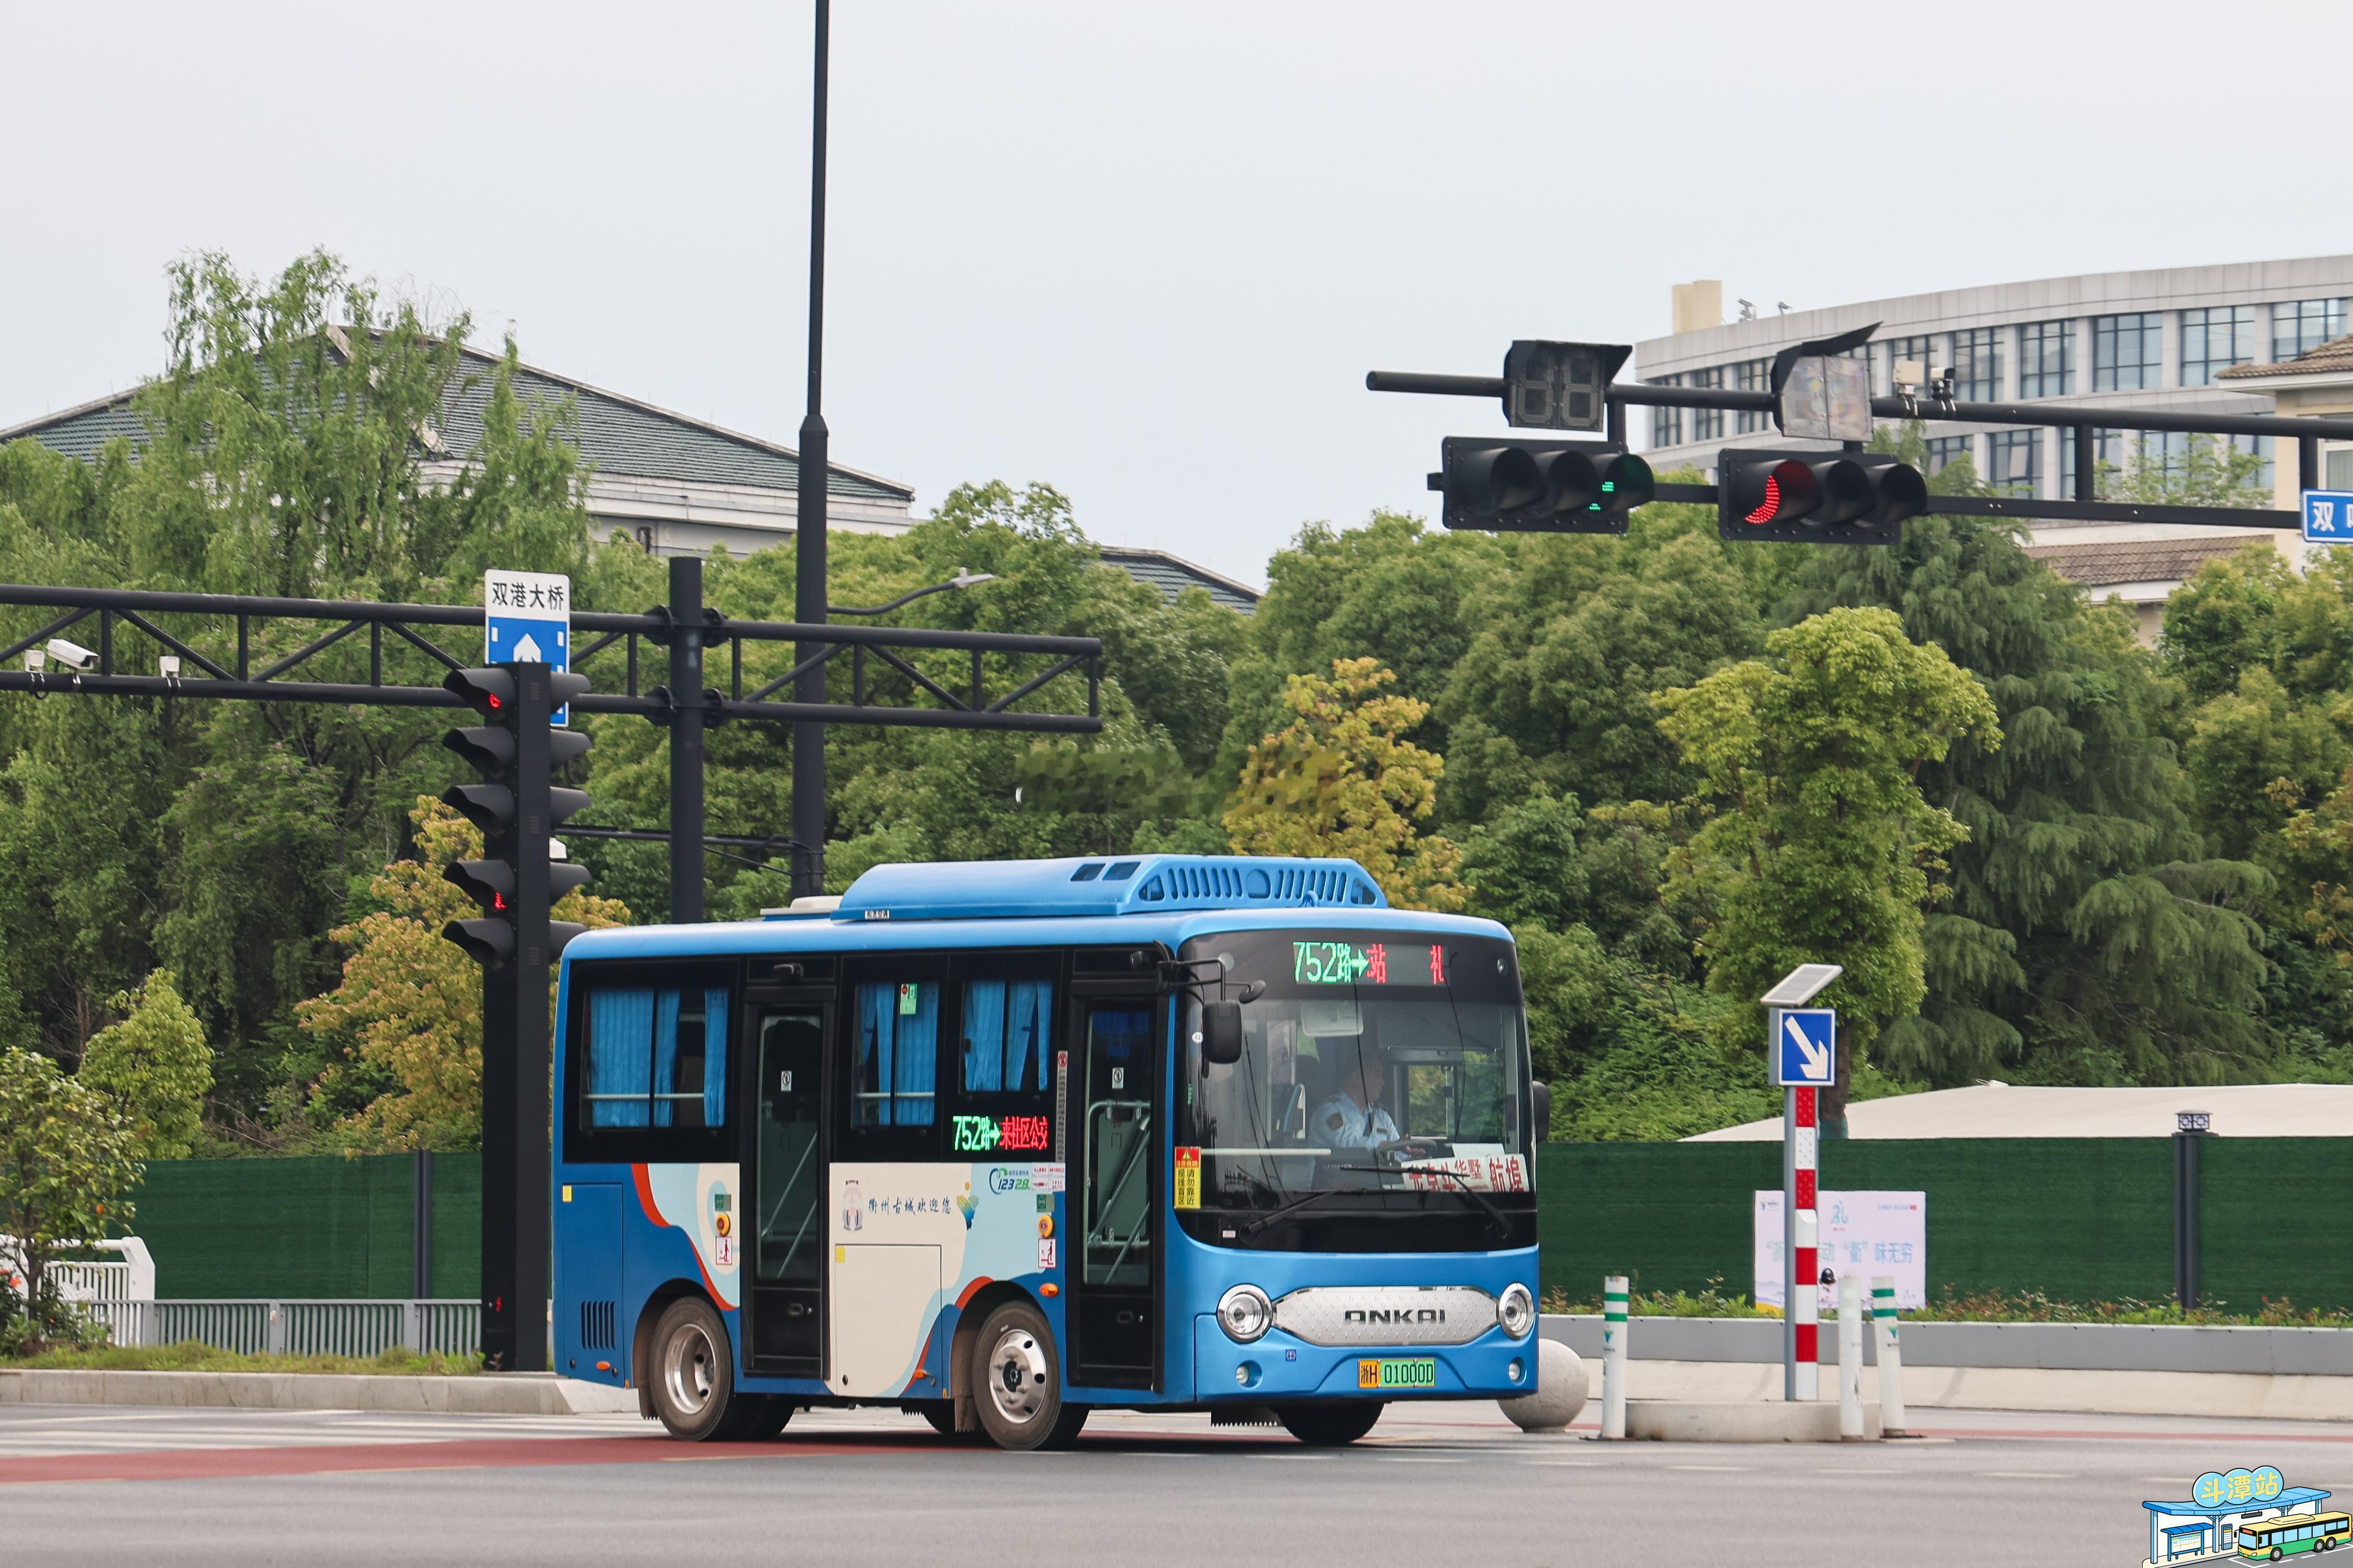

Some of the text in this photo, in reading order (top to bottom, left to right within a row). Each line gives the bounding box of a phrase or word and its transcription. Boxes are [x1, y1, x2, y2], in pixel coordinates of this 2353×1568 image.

[2313, 502, 2353, 533] 双
[492, 582, 564, 611] 双港大桥
[1293, 942, 1352, 983] 752路
[952, 1116, 990, 1150] 752路
[868, 1195, 952, 1215] 衢州古城欢迎您
[1344, 1309, 1445, 1325] ANKAI
[1360, 1364, 1434, 1384] 浙H 01000D
